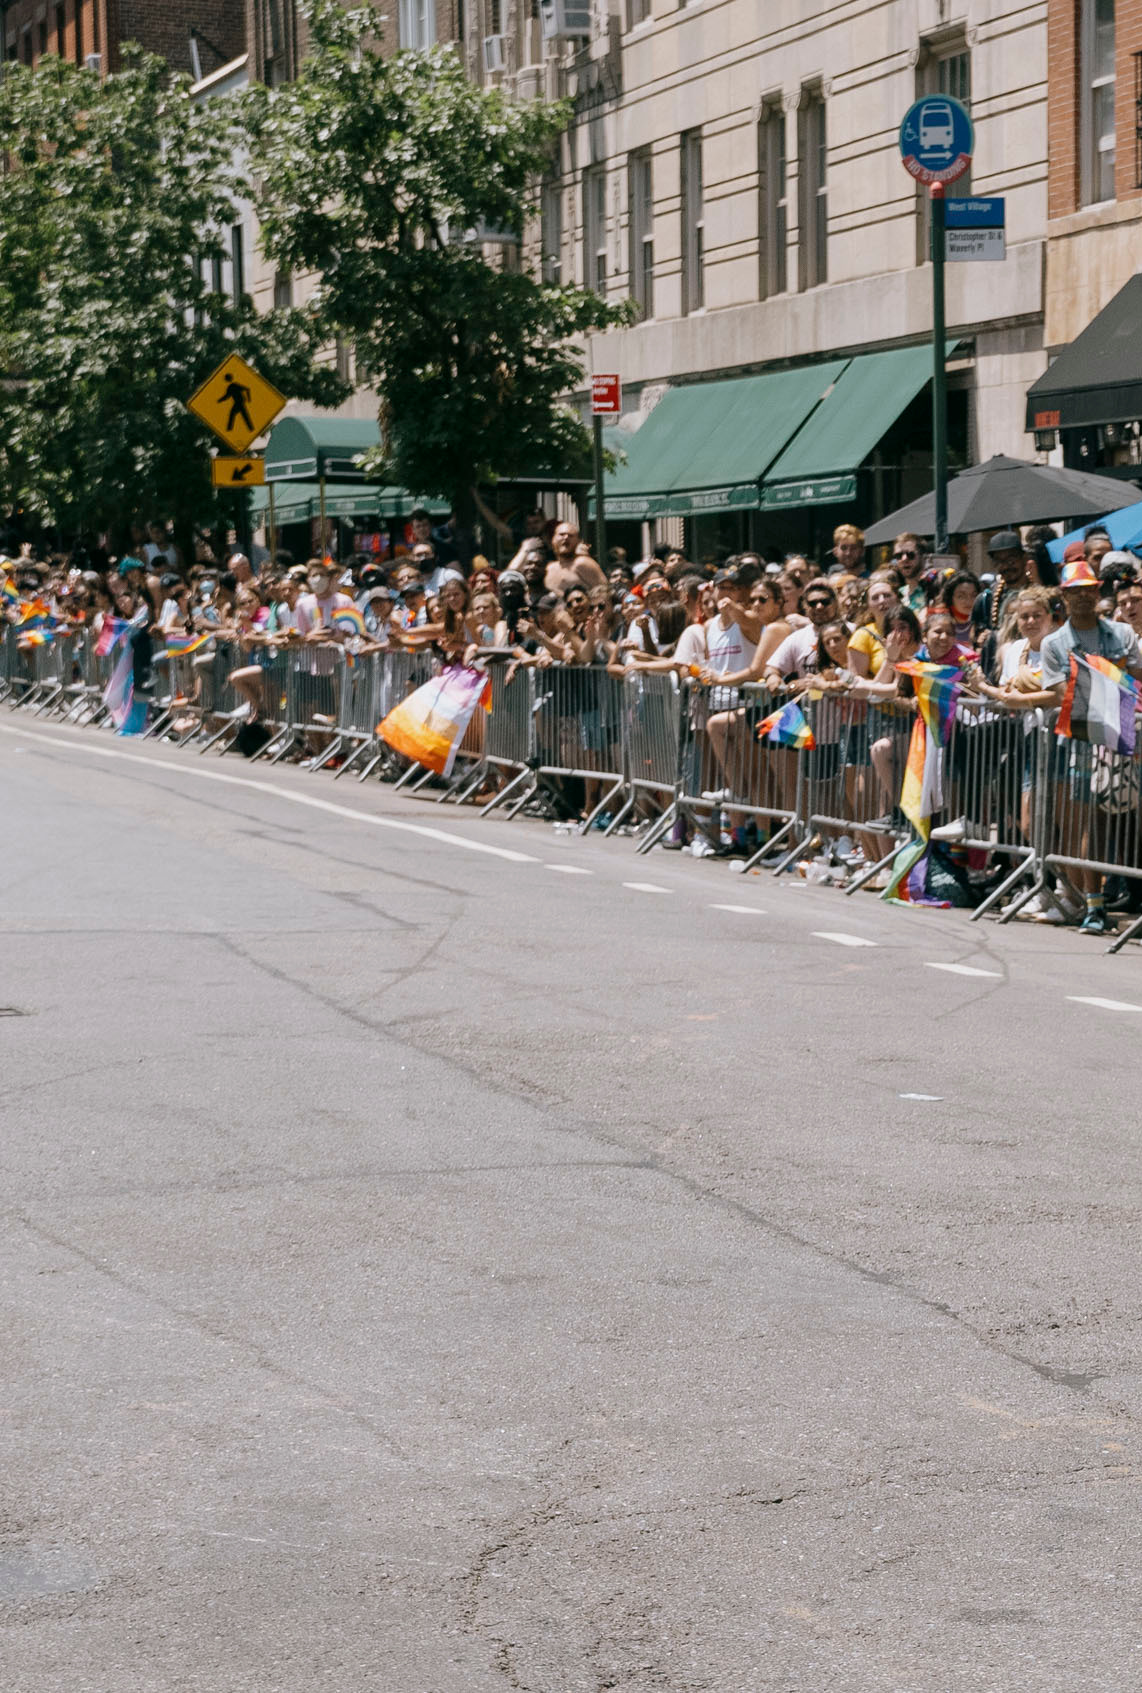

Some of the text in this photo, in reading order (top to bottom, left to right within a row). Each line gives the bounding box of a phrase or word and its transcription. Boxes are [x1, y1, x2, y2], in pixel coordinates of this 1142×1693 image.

[907, 158, 966, 180] NO STANDING
[968, 202, 991, 212] Village
